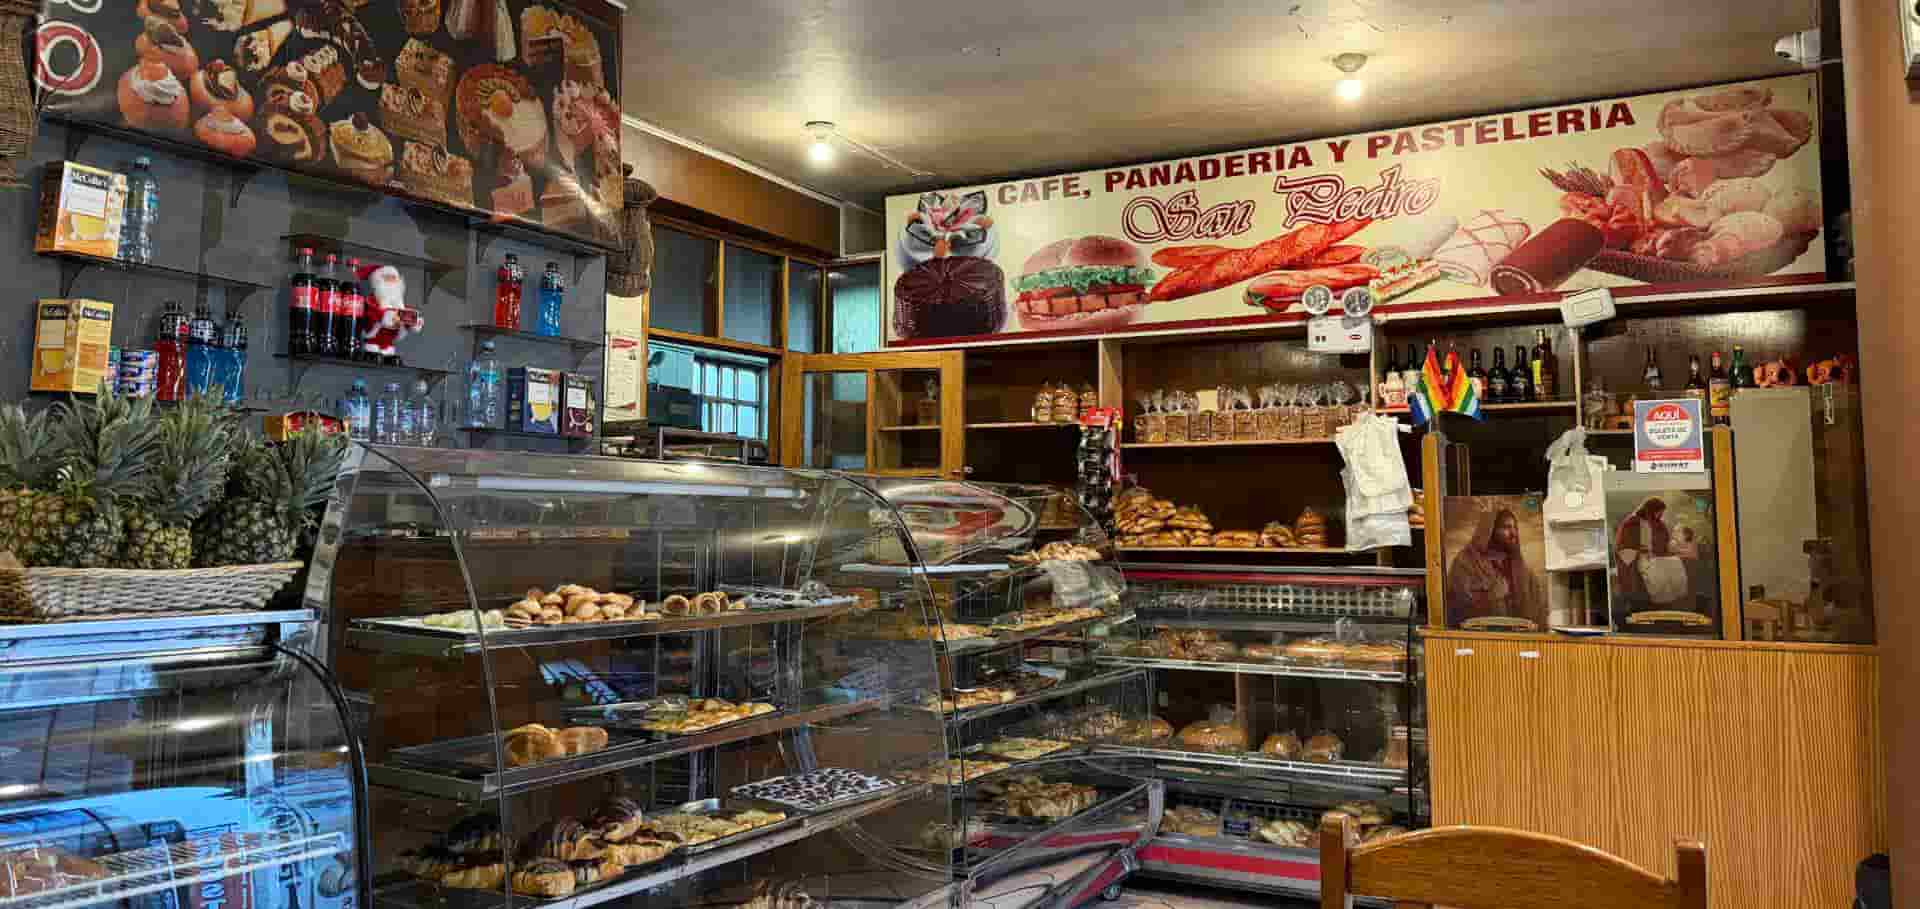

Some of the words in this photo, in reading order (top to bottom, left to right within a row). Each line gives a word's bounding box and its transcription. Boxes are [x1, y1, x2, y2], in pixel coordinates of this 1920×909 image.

[1104, 146, 1312, 192] PANADERIA
[1328, 139, 1351, 163] Y
[1122, 189, 1255, 243] San
[1274, 163, 1440, 229] Pedro
